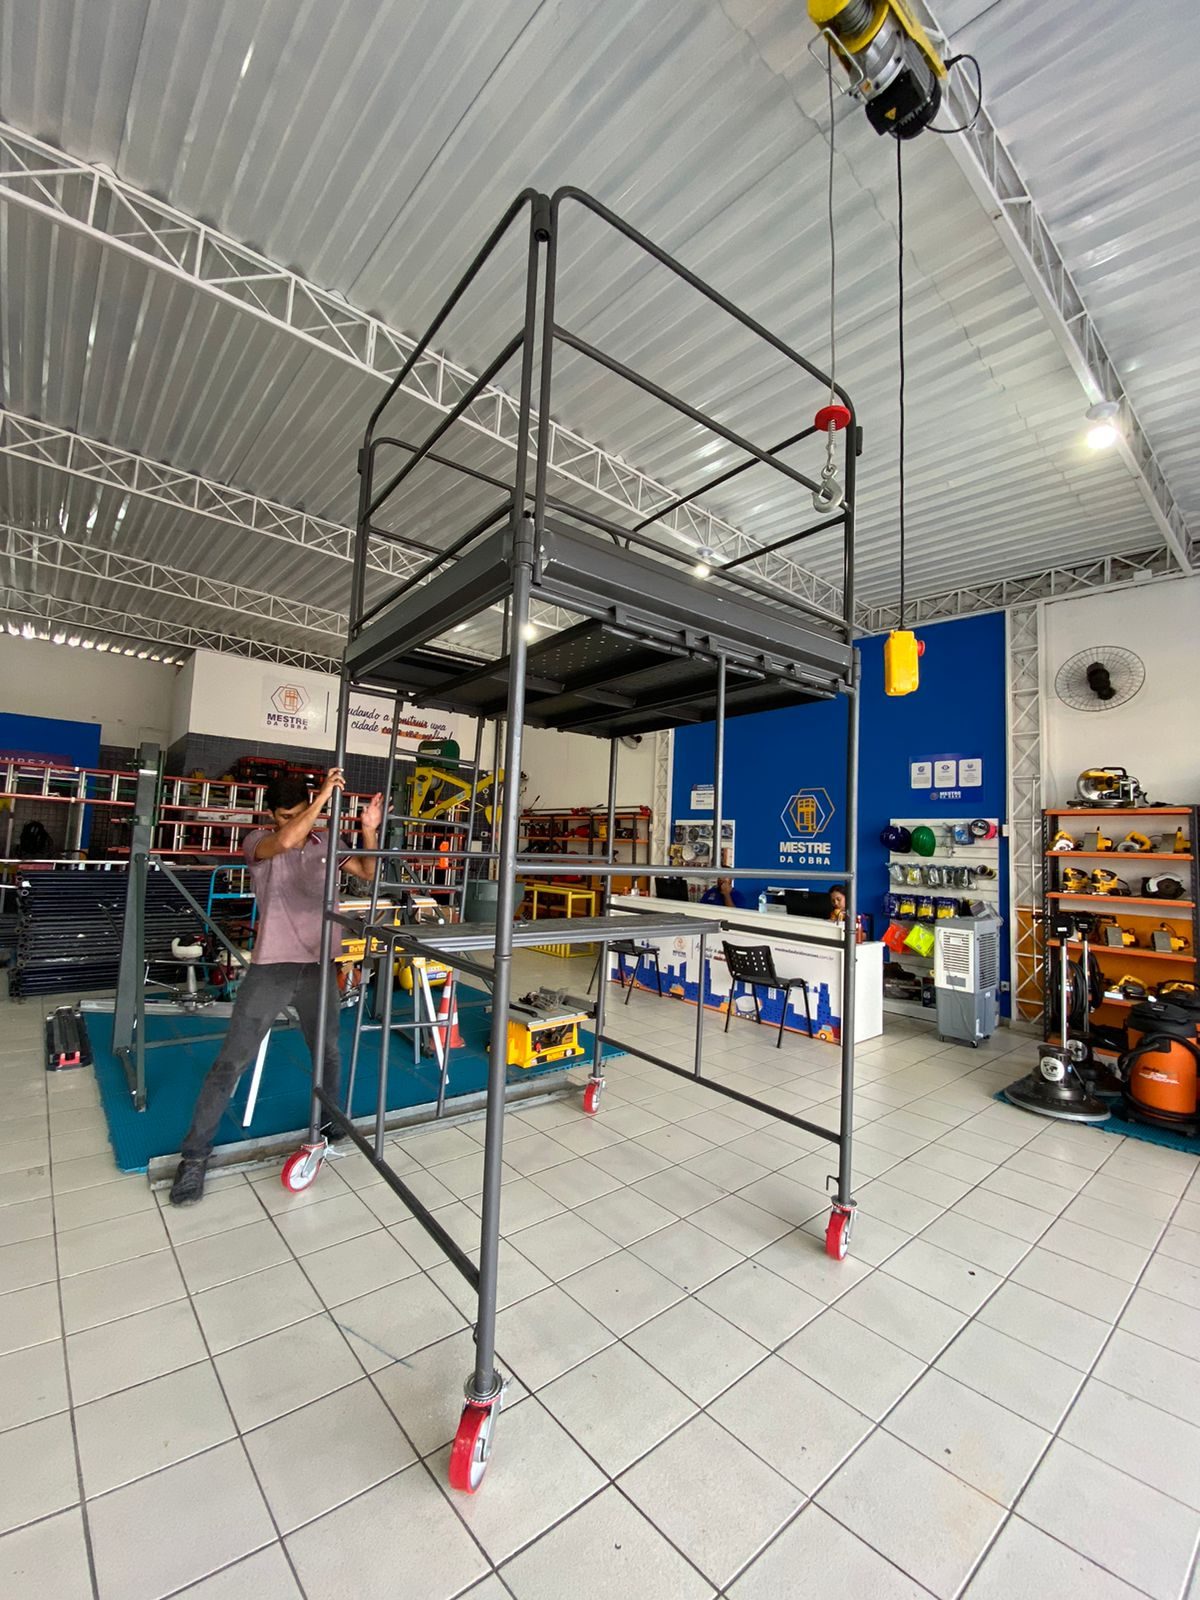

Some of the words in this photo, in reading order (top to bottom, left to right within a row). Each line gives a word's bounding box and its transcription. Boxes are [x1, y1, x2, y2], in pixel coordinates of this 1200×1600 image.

[266, 713, 308, 726] MESTRE
[351, 719, 380, 732] cidade
[283, 722, 308, 731] OBRA
[779, 841, 831, 855] MESTRE
[779, 855, 794, 864] DA
[798, 856, 831, 865] OBRA
